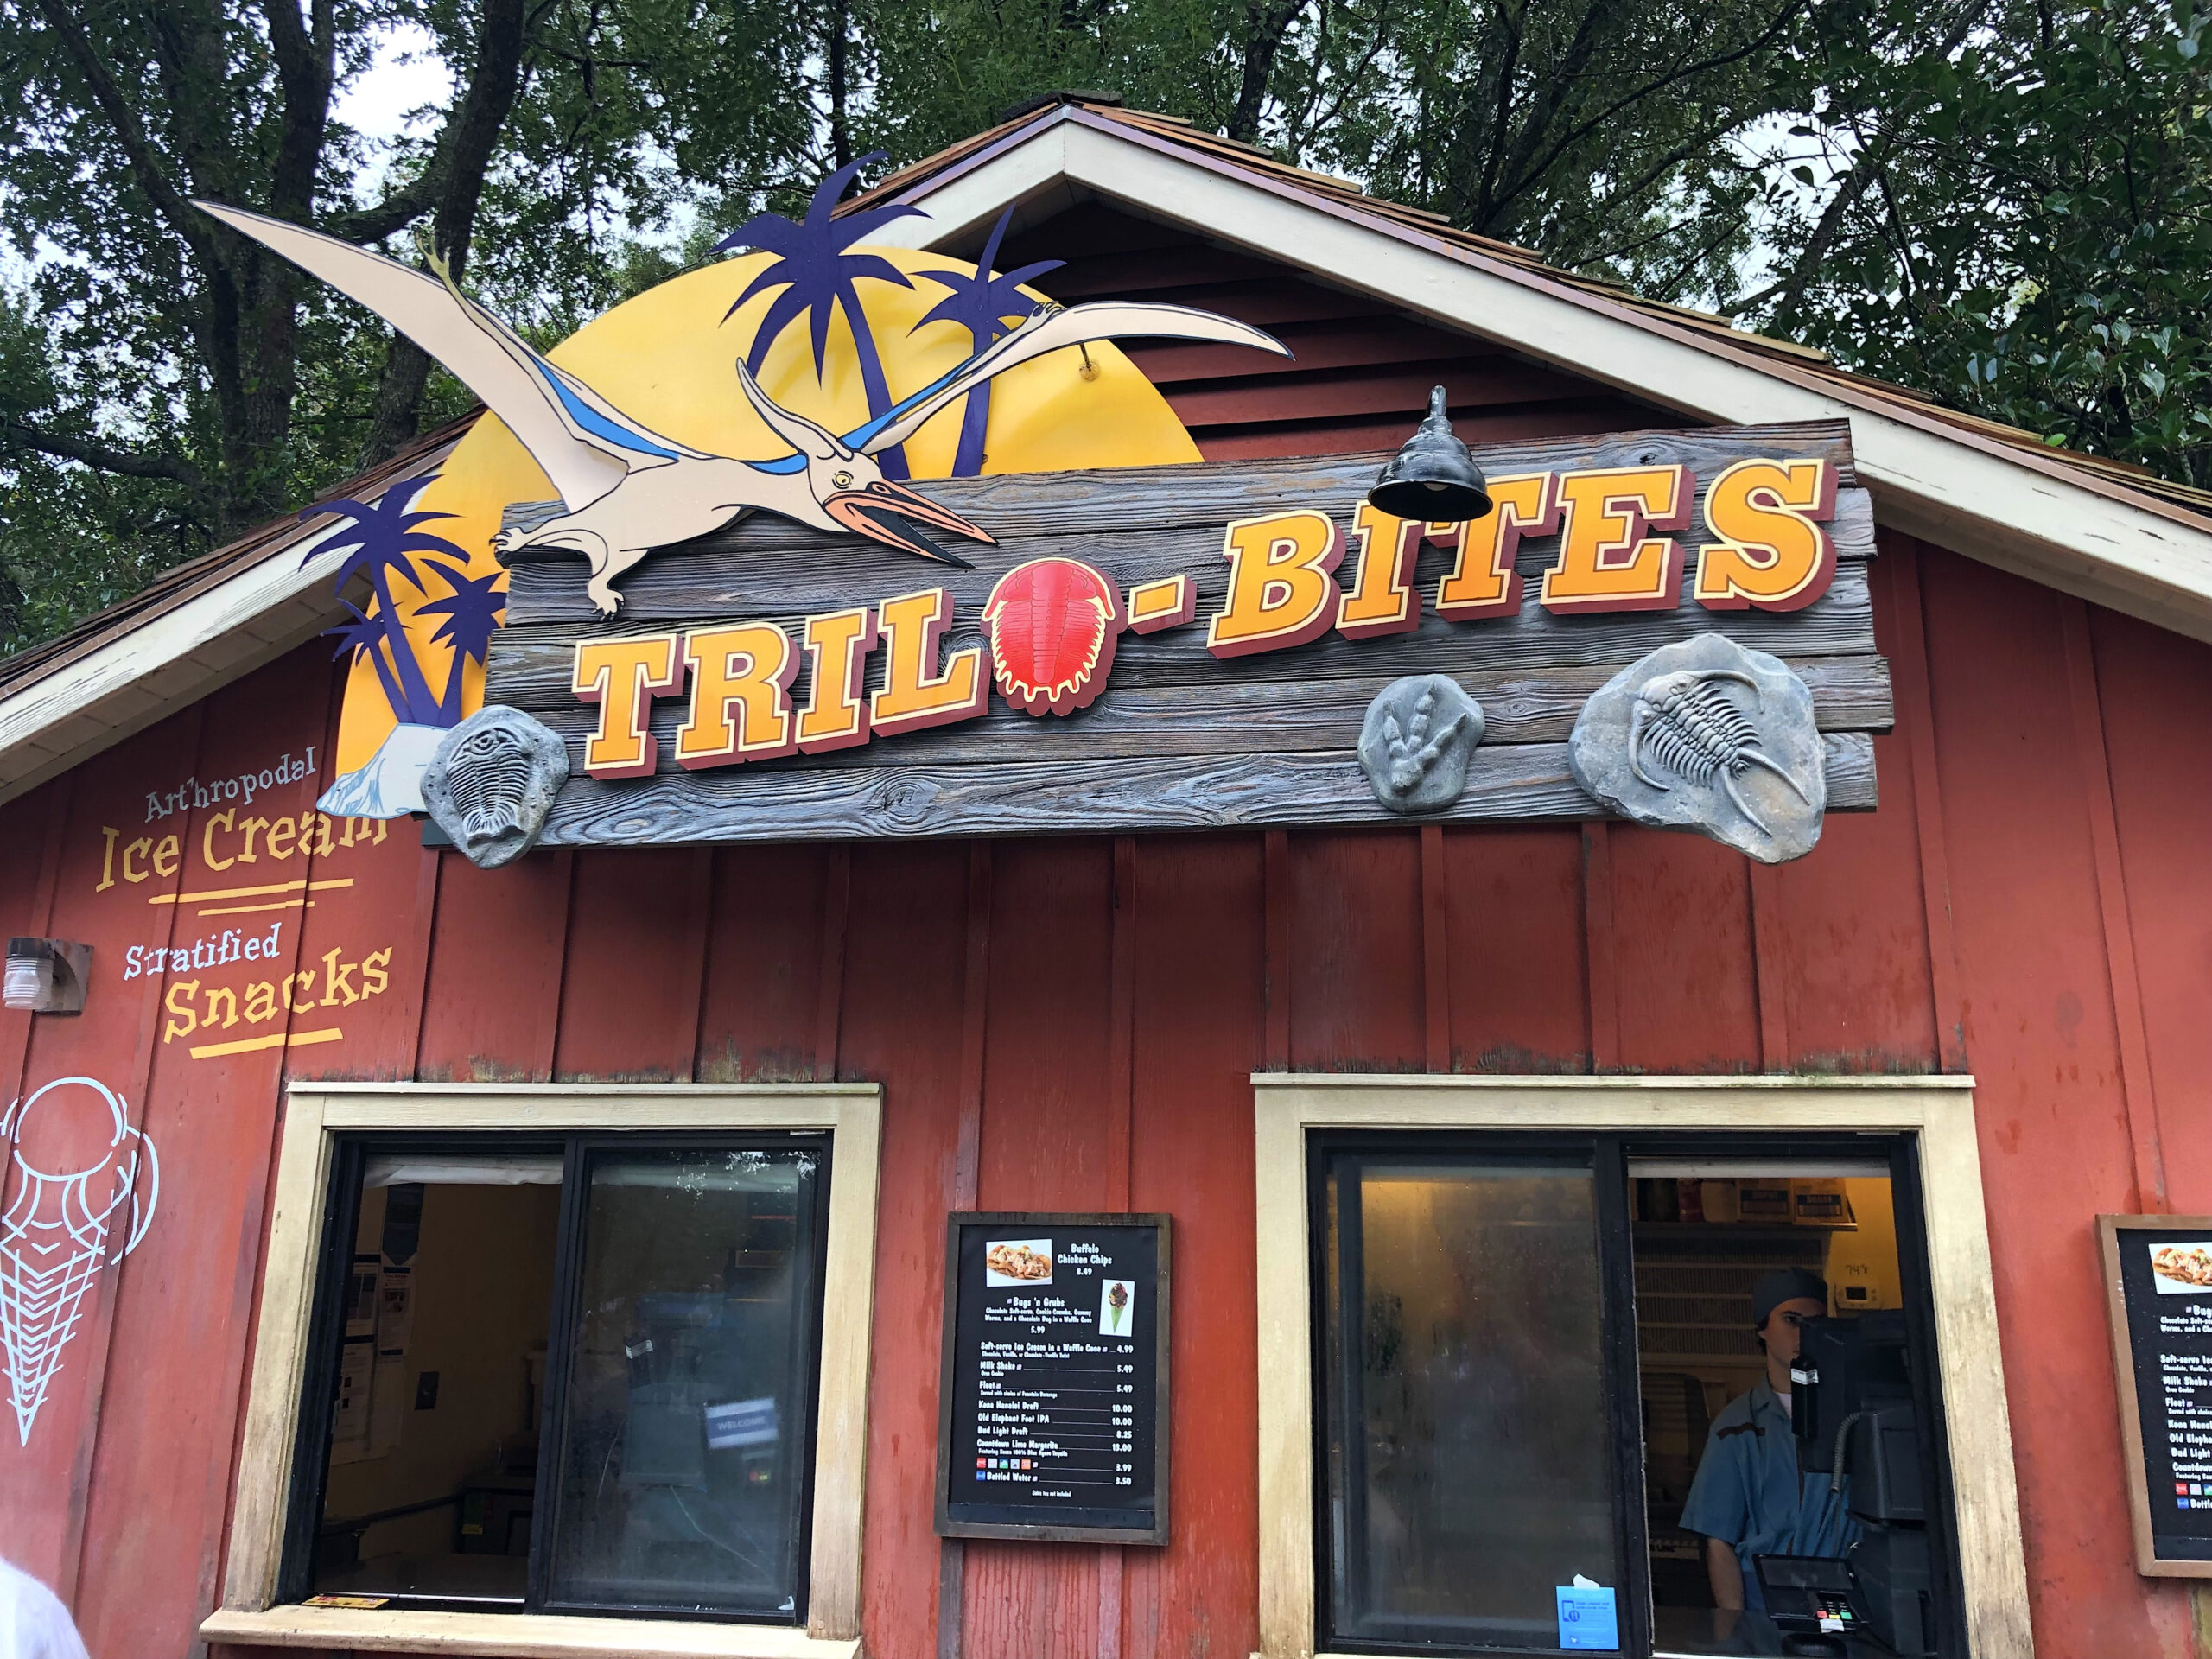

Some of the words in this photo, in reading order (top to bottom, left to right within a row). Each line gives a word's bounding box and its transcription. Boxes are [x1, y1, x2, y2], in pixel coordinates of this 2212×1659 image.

[145, 746, 316, 823] Arthropodal
[96, 826, 180, 893] Ice
[203, 808, 387, 871] Cream
[124, 922, 282, 981] Stratified
[163, 946, 392, 1044] Snacks
[1071, 1243, 1100, 1254] Buffalo
[1057, 1254, 1088, 1264] Chicken
[1090, 1255, 1113, 1268] Chips
[1013, 1297, 1032, 1308] Bugs
[1043, 1297, 1065, 1306] Grubs
[2193, 1305, 2212, 1319] Bug
[1041, 1315, 1052, 1324] Bug
[1030, 1325, 1046, 1334] 5.99
[2160, 1324, 2183, 1332] Worms,
[980, 1341, 1012, 1351] Soft-serve
[1014, 1342, 1025, 1351] Ice
[1026, 1342, 1046, 1351] Cream
[1048, 1343, 1055, 1351] in
[1063, 1343, 1084, 1352] Waffle
[1085, 1344, 1102, 1353] Cone
[1116, 1344, 1134, 1354] 4.99
[2160, 1354, 2200, 1364] Soft-serve
[979, 1361, 995, 1370] Milk
[996, 1361, 1016, 1371] Shake
[1116, 1364, 1134, 1374] 5.49
[979, 1380, 995, 1389] Float
[1116, 1384, 1134, 1394] 5.49
[2163, 1376, 2182, 1385] Milk
[2184, 1376, 2208, 1386] Shake
[978, 1400, 995, 1409] Kona
[995, 1401, 1020, 1410] Hanalei
[1021, 1401, 1039, 1411] Draft
[1112, 1404, 1133, 1414] 10.00
[2164, 1397, 2185, 1407] Float
[717, 1416, 766, 1431] WELCOME
[977, 1413, 990, 1422] Old
[991, 1413, 1020, 1425] Elephant
[1020, 1414, 1036, 1424] Foot
[1037, 1414, 1050, 1424] IPA
[1111, 1417, 1133, 1427] 10.00
[2167, 1419, 2188, 1429] Kona
[977, 1426, 991, 1435] Bud
[992, 1426, 1010, 1437] Light
[1011, 1427, 1029, 1436] Draft
[1116, 1430, 1133, 1440] 8.25
[2169, 1433, 2184, 1443] Old
[2186, 1433, 2212, 1446] Elepha
[976, 1438, 1010, 1448] Countdown
[1011, 1439, 1027, 1448] Lime
[1028, 1440, 1058, 1452] Margarita
[1112, 1443, 1133, 1452] 13.00
[2171, 1447, 2188, 1458] Bud
[2189, 1447, 2211, 1460] Light
[1115, 1463, 1133, 1472] 3.99
[986, 1471, 1011, 1481] Bottled
[1012, 1472, 1032, 1482] Water
[1115, 1476, 1132, 1486] 3.50
